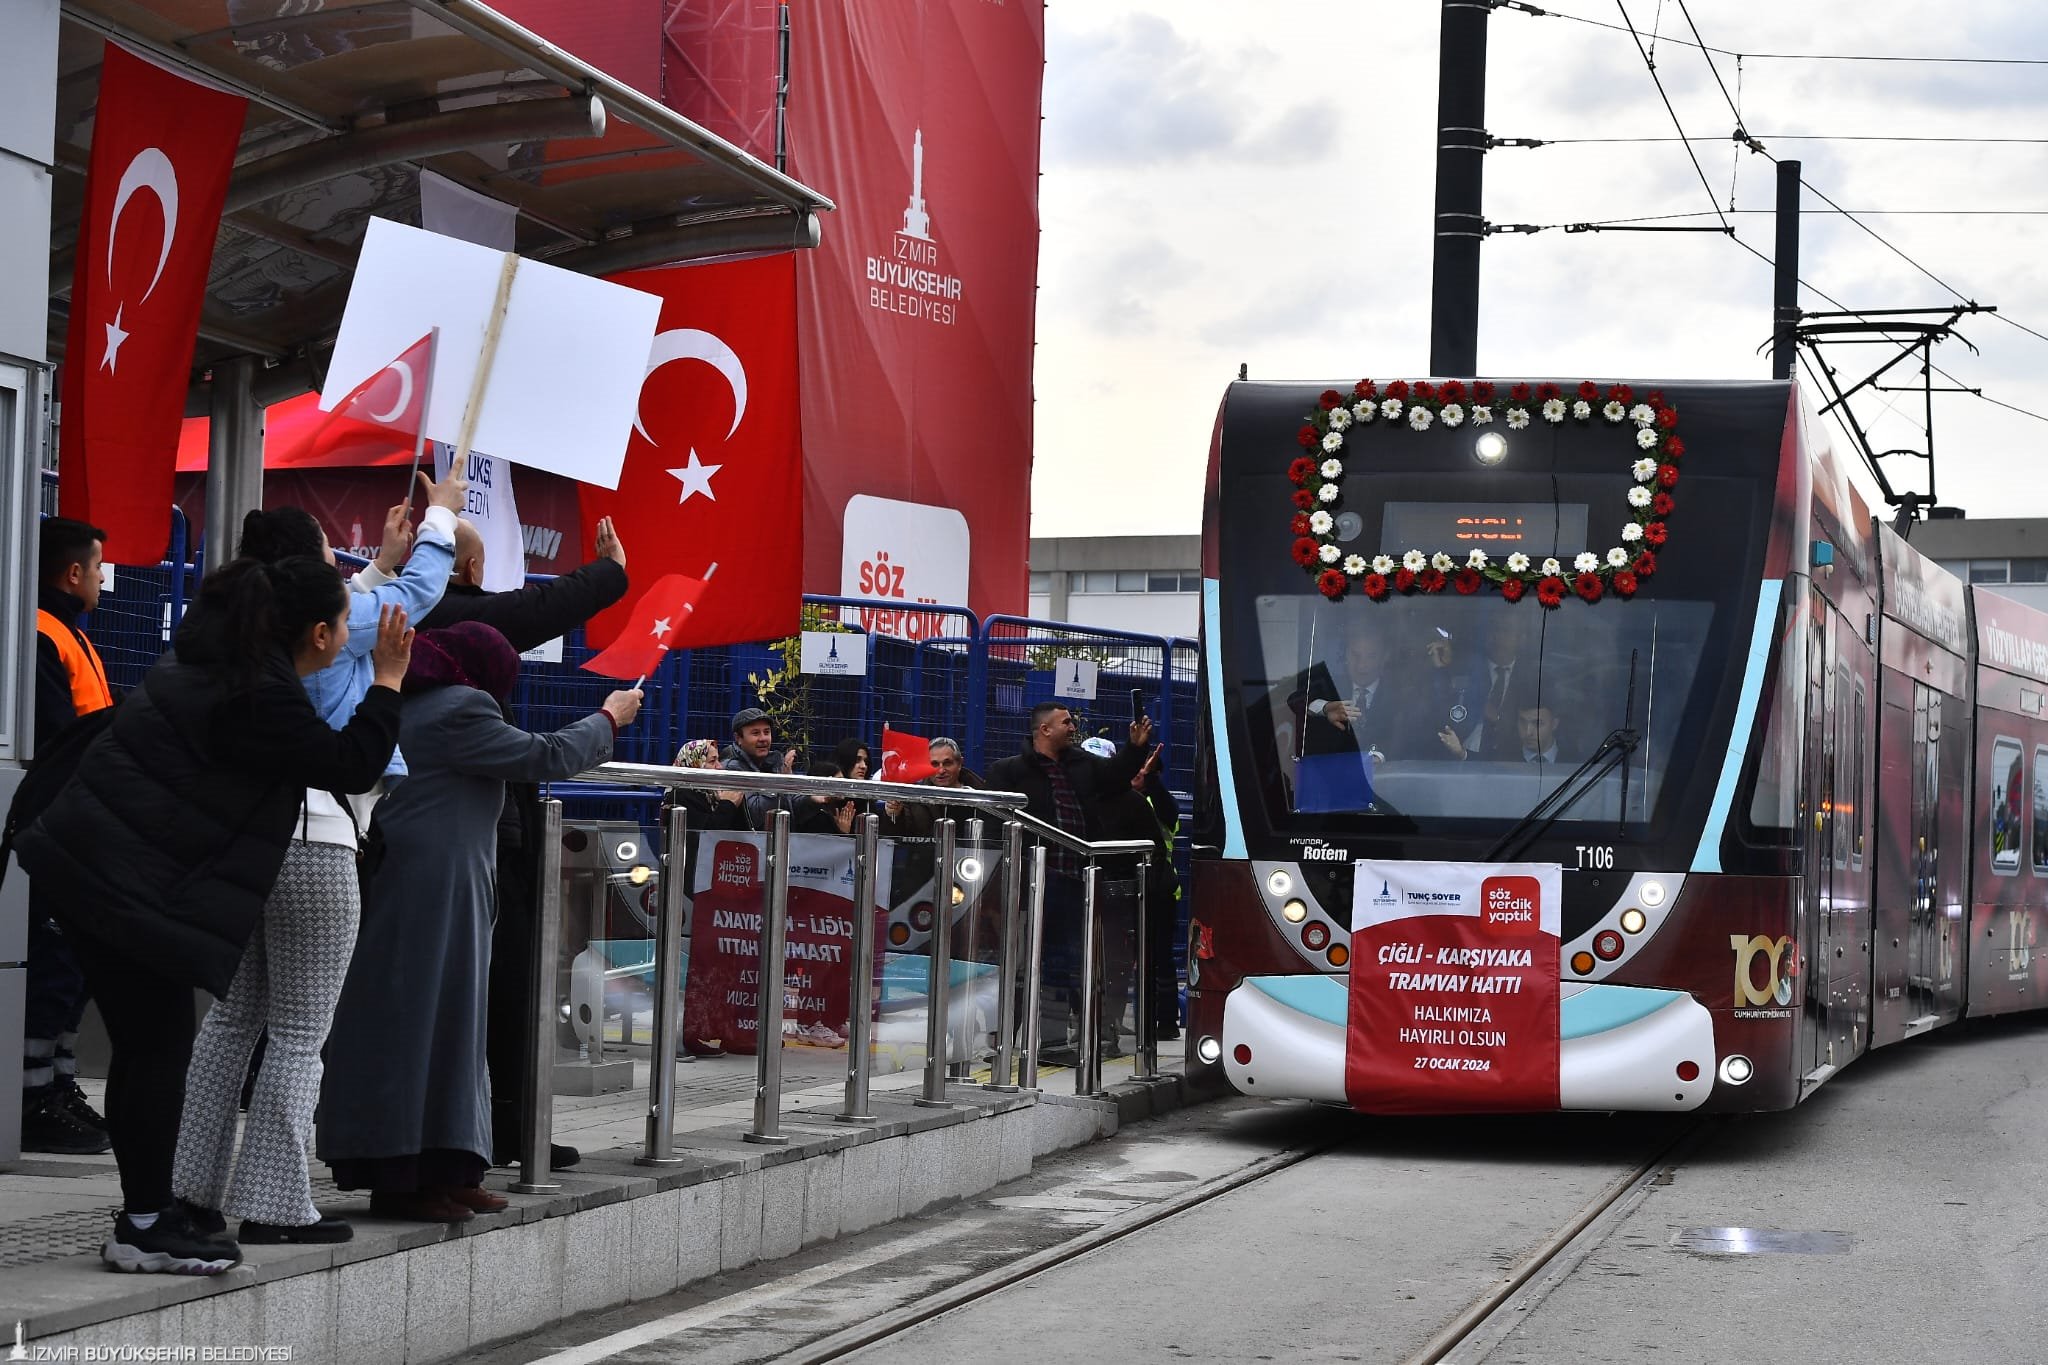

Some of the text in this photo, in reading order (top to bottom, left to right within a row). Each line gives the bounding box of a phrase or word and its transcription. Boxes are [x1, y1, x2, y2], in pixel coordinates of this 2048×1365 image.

[893, 235, 937, 267] İZMİR
[867, 255, 961, 301] BÜYÜKŞEHİR
[870, 286, 956, 326] BELEDİYESİ
[859, 550, 905, 598] söz
[1303, 843, 1348, 861] Rotem
[1575, 846, 1614, 869] T106
[1407, 892, 1431, 902] TUNÇ
[1432, 893, 1461, 901] SOYER
[1489, 888, 1511, 900] söz
[1489, 898, 1532, 910] verdik
[1488, 910, 1533, 924] yaptık
[1377, 942, 1424, 965] ÇİĞLİ
[1435, 947, 1532, 969] KARŞIYAKA
[1388, 972, 1522, 994] TRAMVAY HATTI
[1413, 1005, 1492, 1024] HALKIMIZA
[1399, 1027, 1506, 1047] HAYIRLI OLSUN
[1413, 1057, 1491, 1071] 27 OCAK 2024
